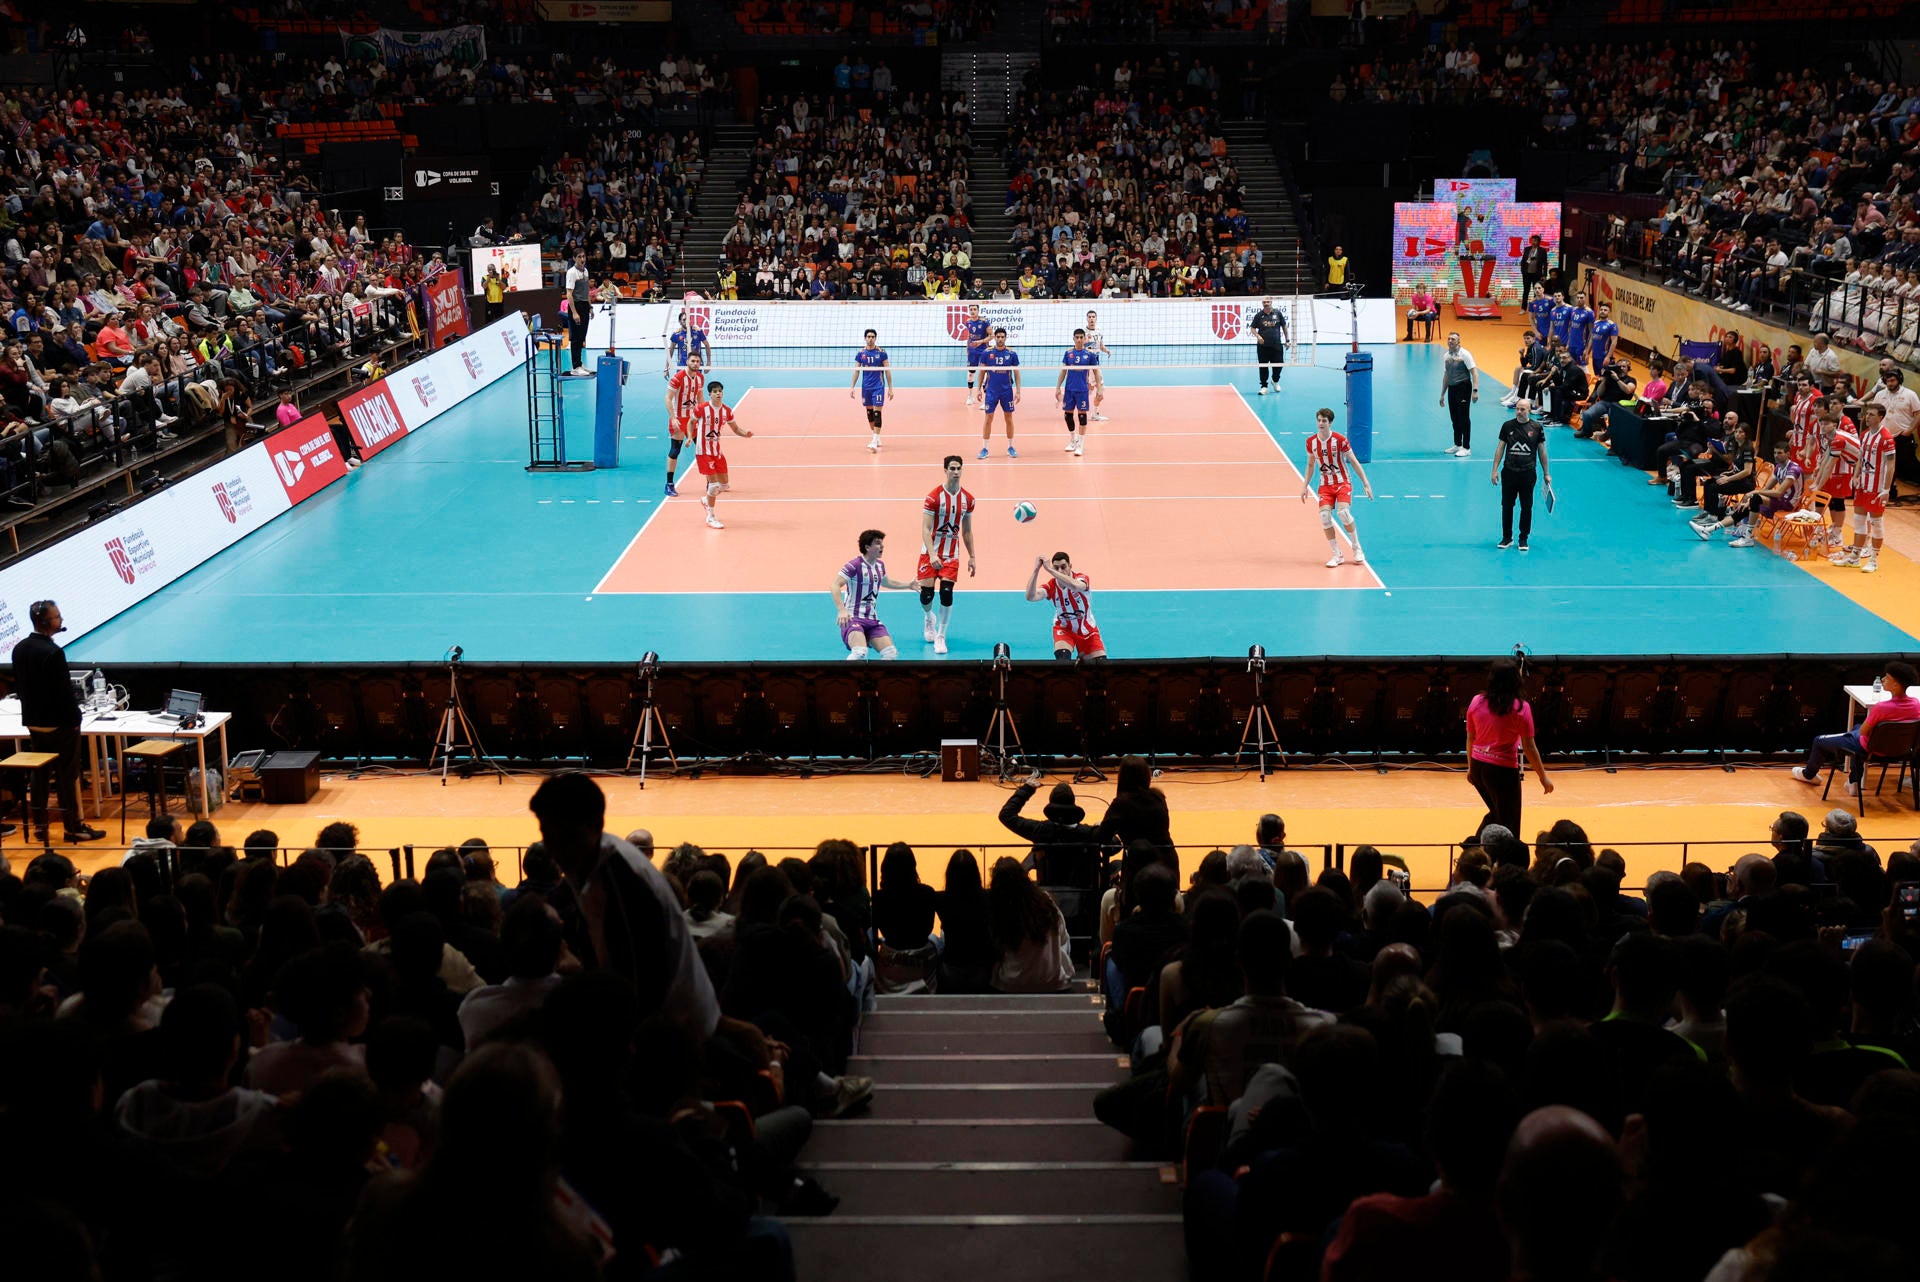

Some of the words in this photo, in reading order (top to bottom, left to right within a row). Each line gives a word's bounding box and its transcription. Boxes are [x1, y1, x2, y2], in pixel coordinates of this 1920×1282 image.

[1645, 298, 1656, 313] REY
[715, 308, 756, 316] Fundació
[715, 316, 758, 325] Esportiva
[985, 315, 1024, 324] sportiva
[715, 324, 759, 333] Municipal
[995, 356, 1004, 365] 13
[349, 393, 401, 449] VALÈNCIA
[952, 505, 956, 513] 1
[1064, 598, 1070, 606] 5
